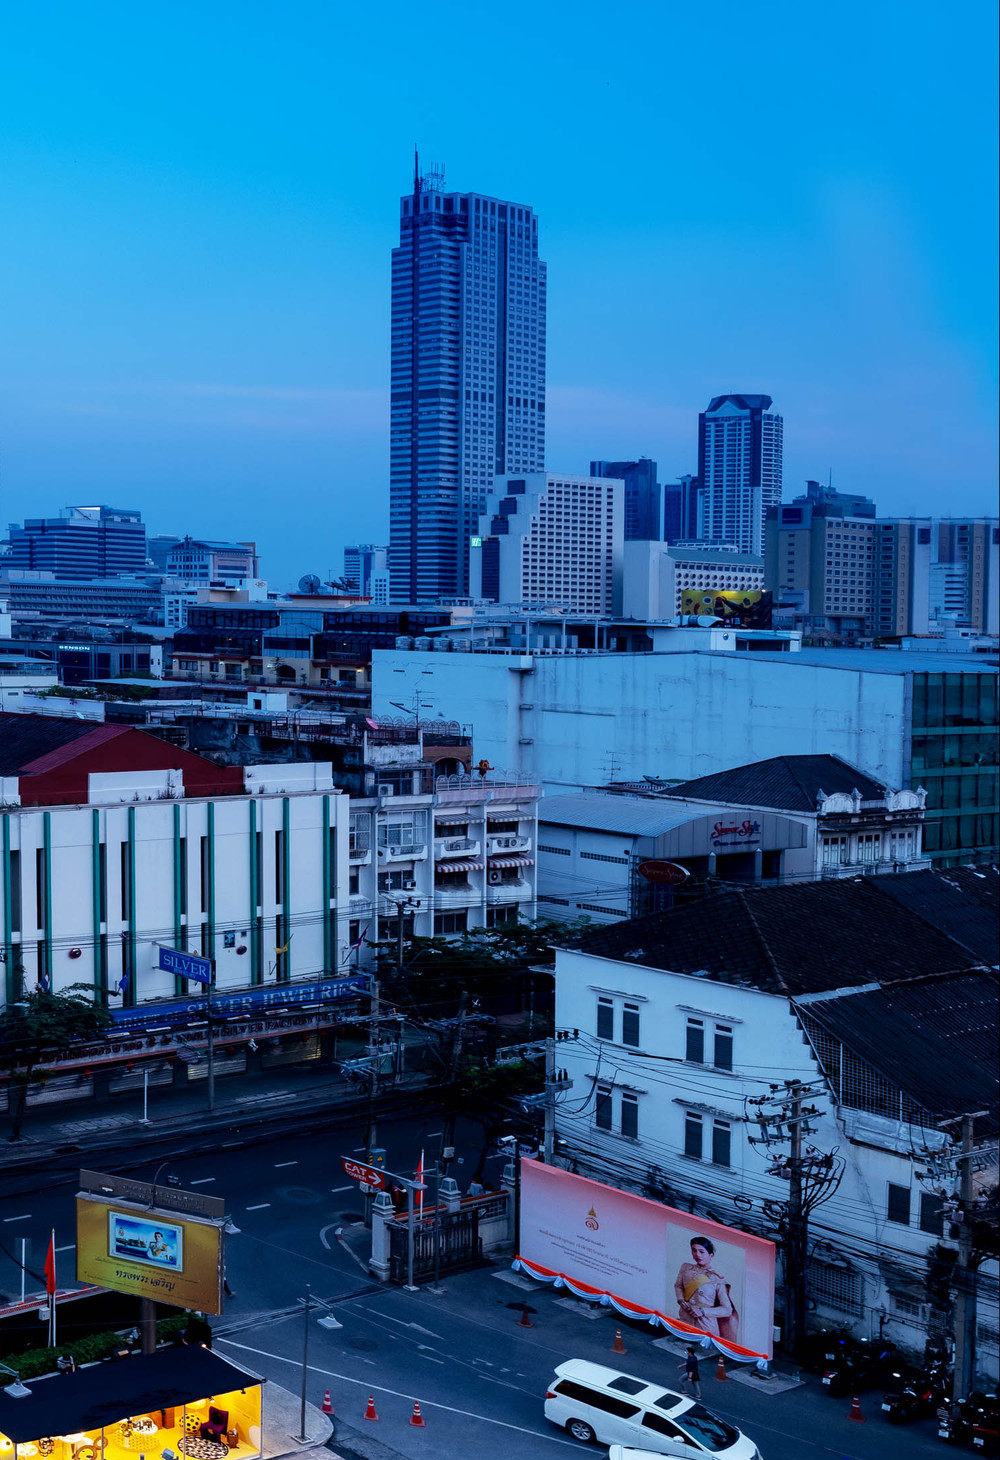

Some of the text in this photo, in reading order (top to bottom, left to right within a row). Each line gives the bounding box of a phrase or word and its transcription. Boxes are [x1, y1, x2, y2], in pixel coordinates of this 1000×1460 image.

[163, 954, 207, 977] SILVER
[344, 1162, 367, 1175] CAT
[344, 1169, 367, 1181] TOWER
